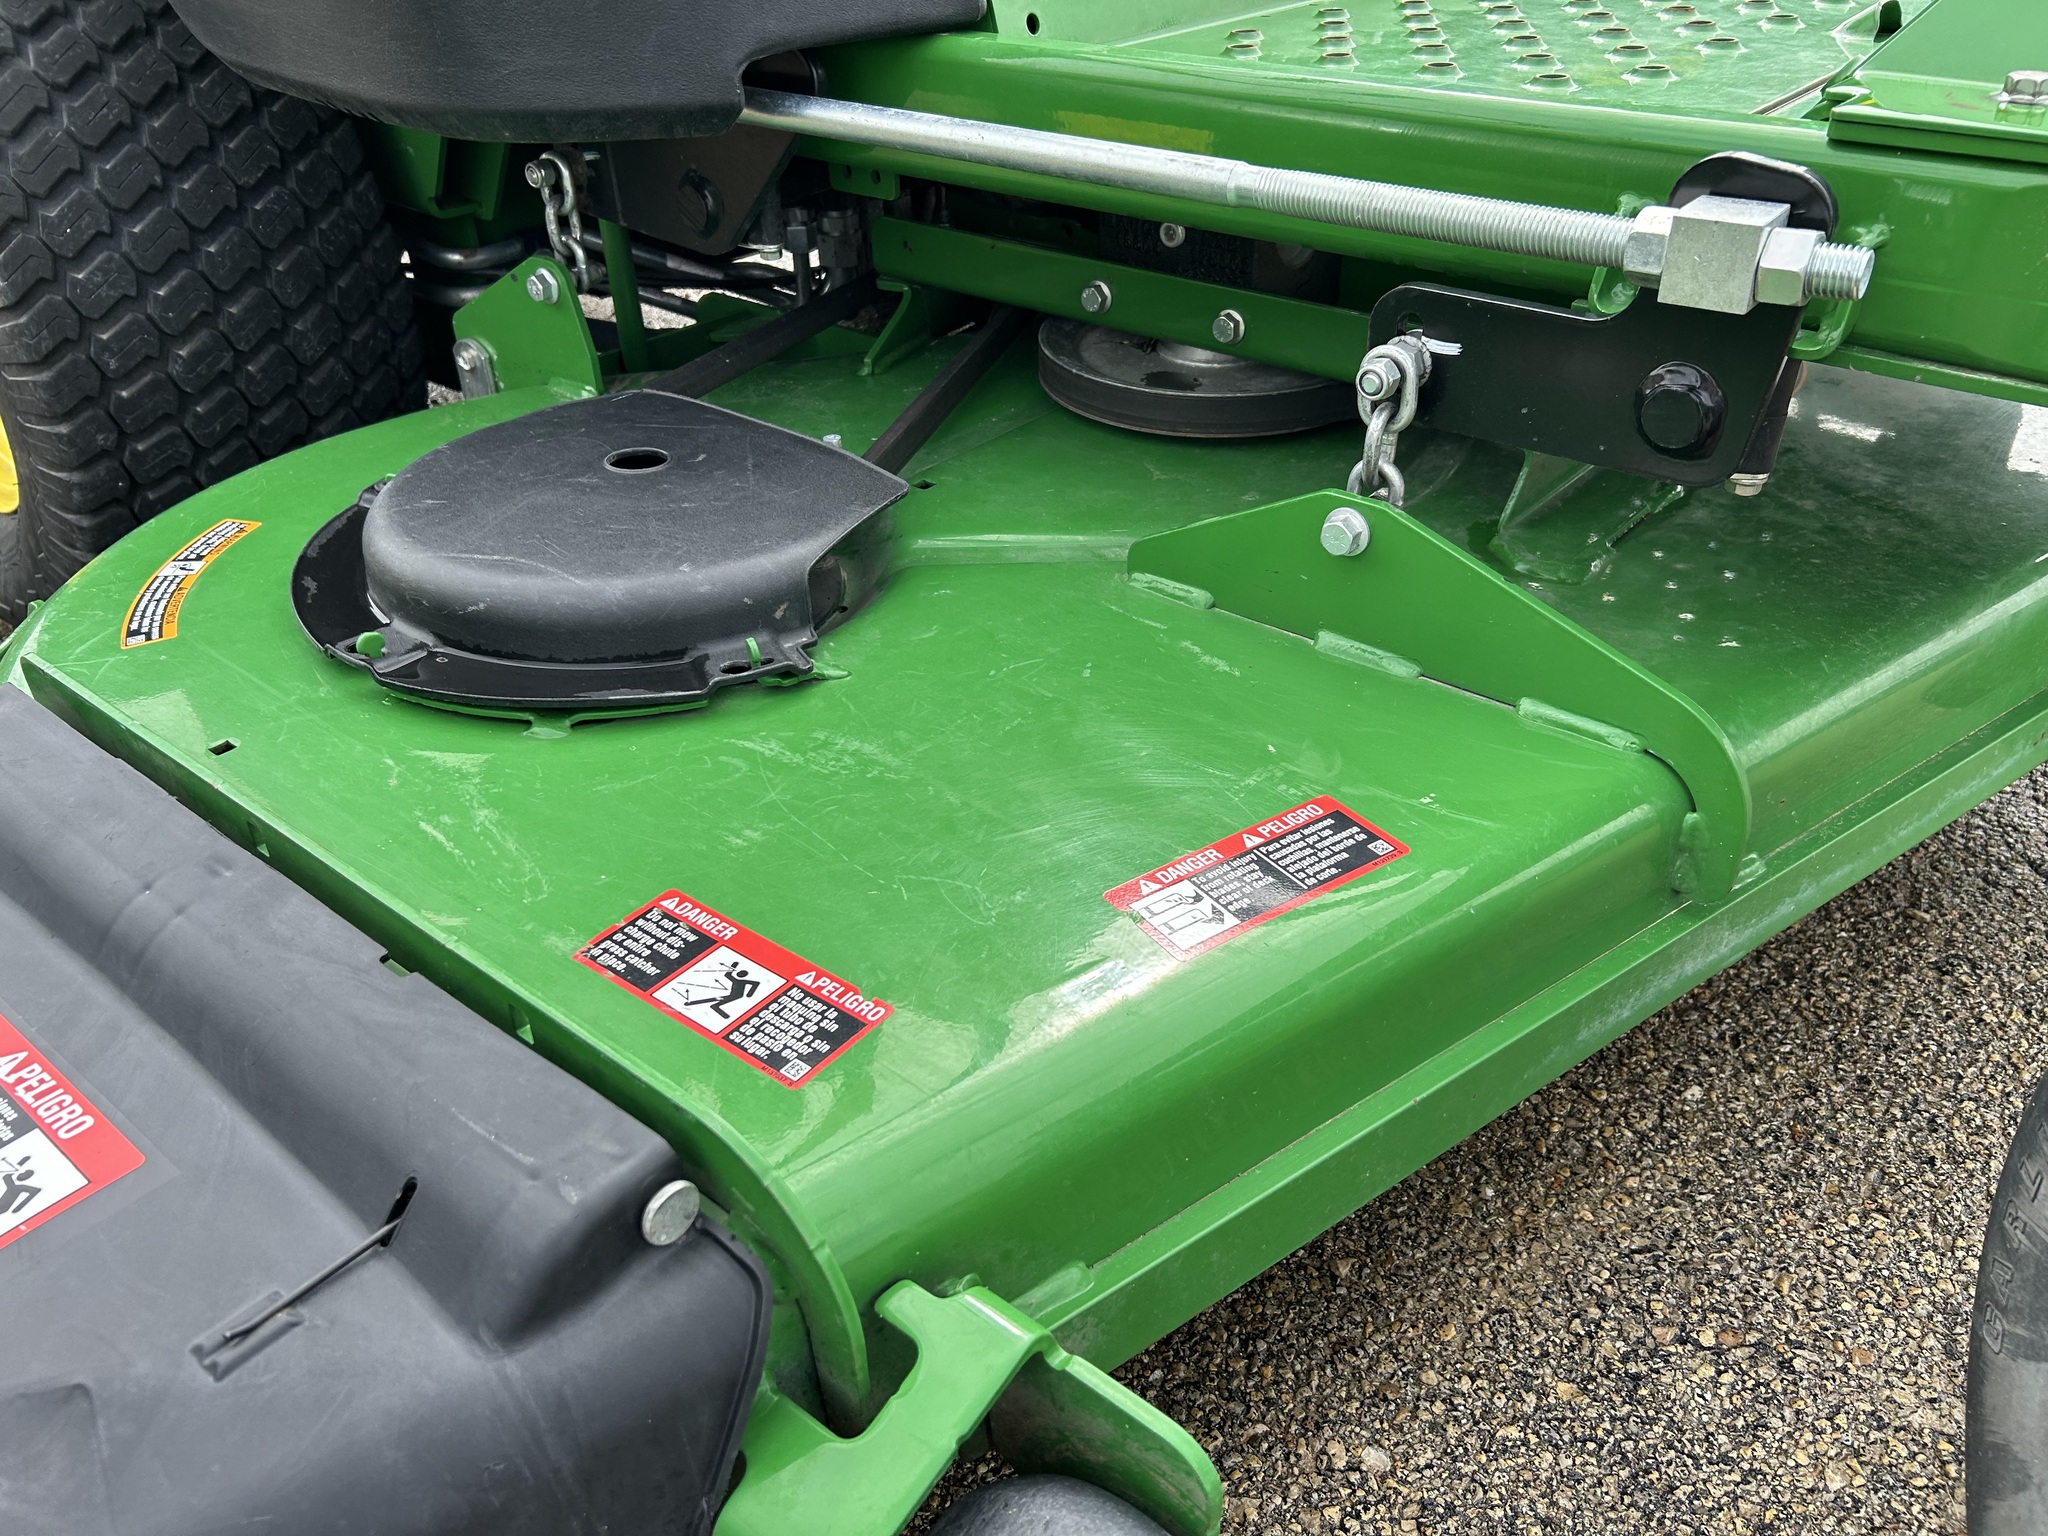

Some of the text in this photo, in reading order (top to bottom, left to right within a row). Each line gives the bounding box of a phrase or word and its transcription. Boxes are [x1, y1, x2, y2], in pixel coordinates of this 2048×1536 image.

[1257, 804, 1324, 837] PELIGRO
[1260, 818, 1335, 855] Para evitar lesiones
[1268, 829, 1334, 860] causadas por las
[1286, 832, 1368, 873] alejado del borde de
[1315, 826, 1361, 850] mantenerse
[1154, 849, 1224, 883] DANGER
[1191, 853, 1258, 885] To avoid injury
[1200, 863, 1260, 892] from rotating
[1243, 870, 1264, 883] stay
[1294, 852, 1350, 880] la plataforma
[1303, 867, 1342, 886] de corte.
[1218, 875, 1276, 904] clear of deck
[635, 918, 668, 940] without
[646, 910, 699, 942] Do not mow
[674, 902, 738, 941] DANGER
[590, 947, 601, 957] in
[600, 940, 661, 976] grass catcher
[612, 933, 652, 957] or entire
[624, 926, 681, 960] charge chute
[787, 986, 838, 1019] No usar la
[811, 976, 886, 1021] PELIGRO
[758, 1009, 831, 1053] descarga o sin
[768, 1002, 819, 1033] el tubo de
[819, 1018, 839, 1033] sin
[729, 1031, 772, 1060] su lugar.
[739, 1024, 798, 1061] de pasto en
[749, 1016, 813, 1056] el recogedor
[14, 1062, 95, 1140] PELIGRO
